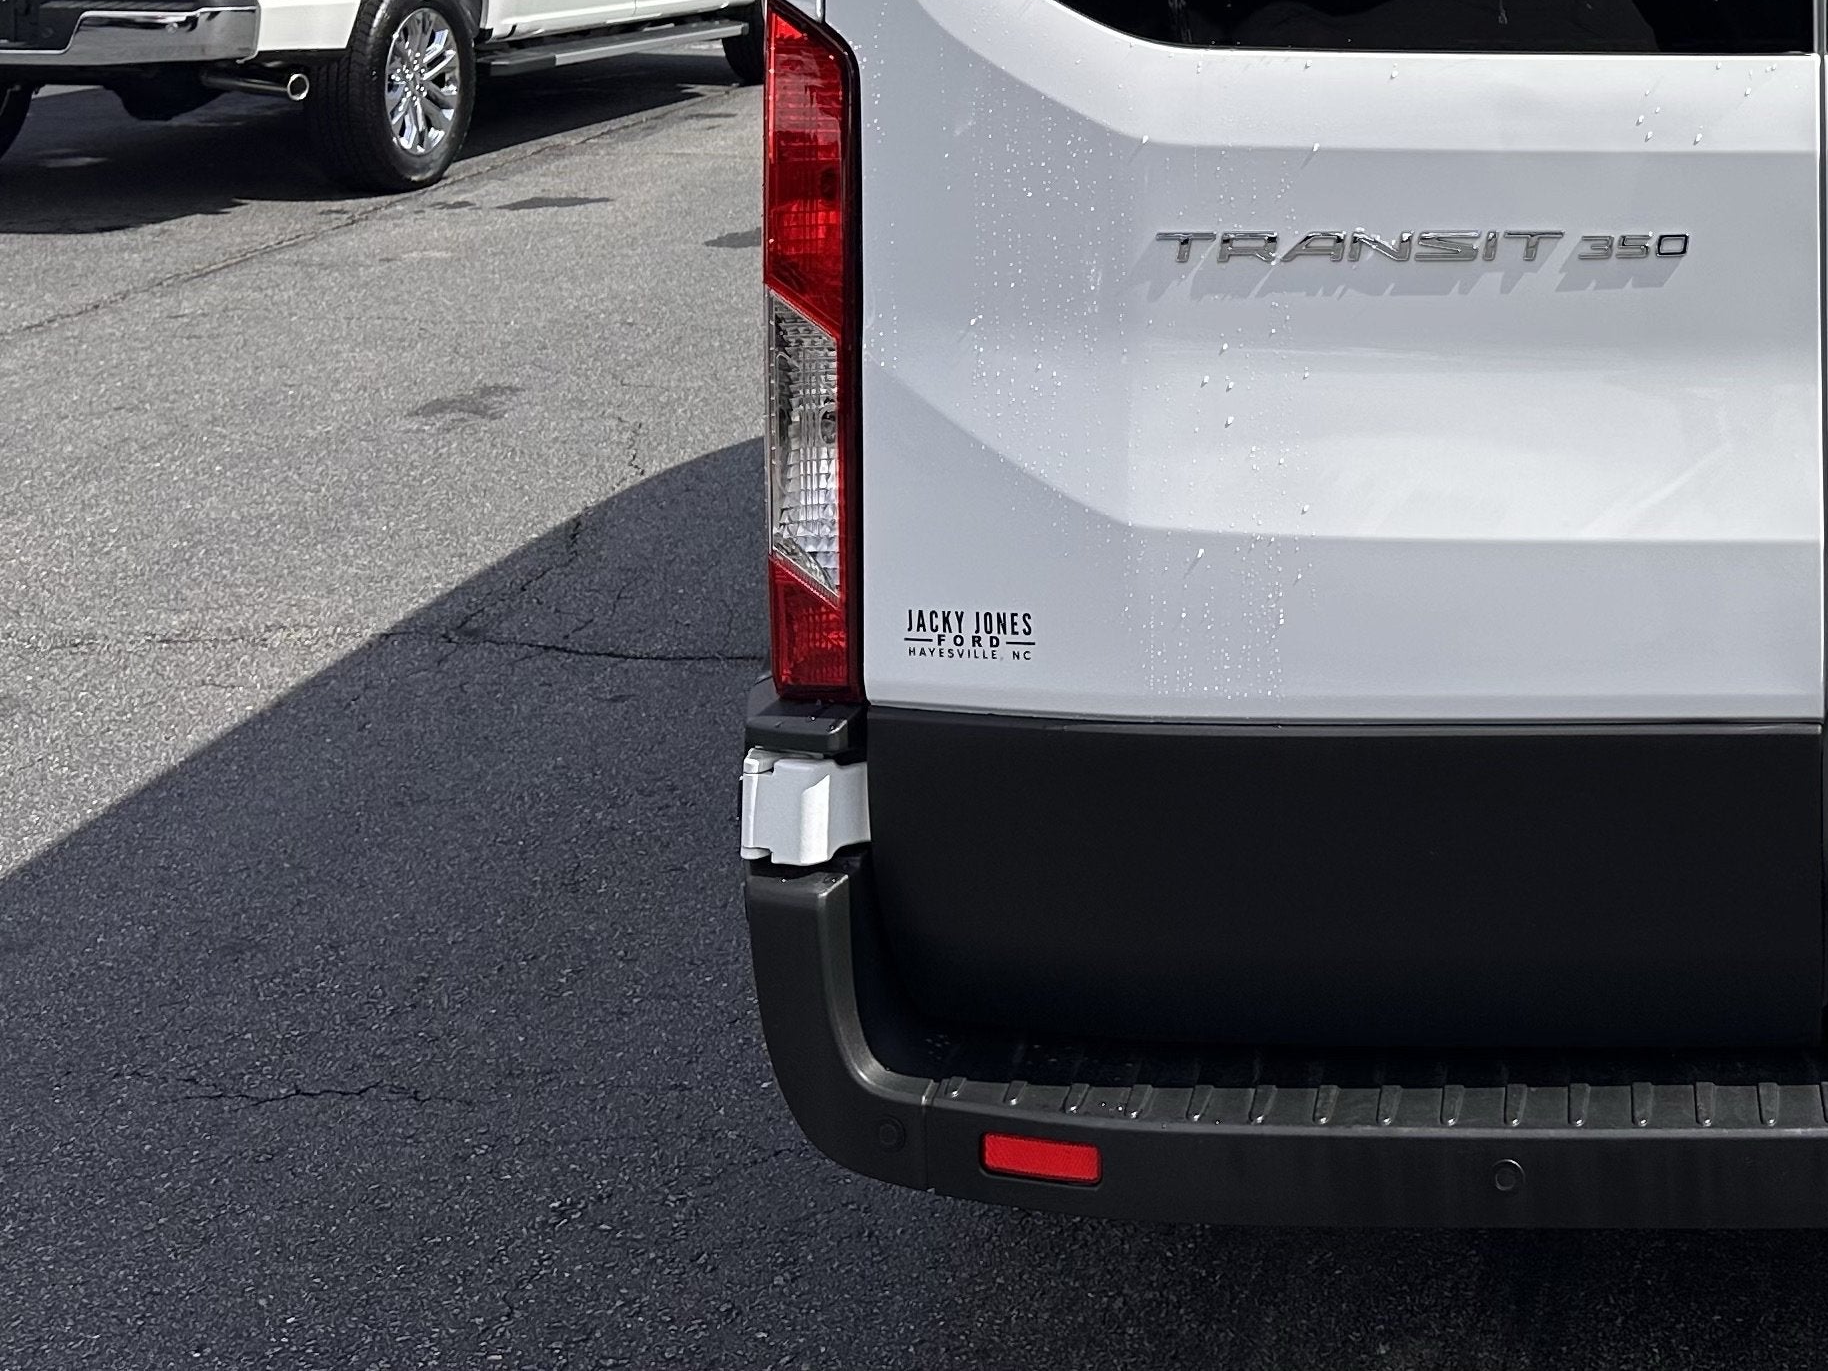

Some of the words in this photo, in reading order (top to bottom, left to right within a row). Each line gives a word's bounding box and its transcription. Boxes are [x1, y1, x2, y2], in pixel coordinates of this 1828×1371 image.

[1155, 229, 1566, 262] TRANSIT
[1577, 233, 1691, 259] 350
[907, 609, 964, 634] JACKY
[974, 611, 1032, 636] JONES
[937, 634, 1000, 648] FORD
[1012, 650, 1032, 661] NC
